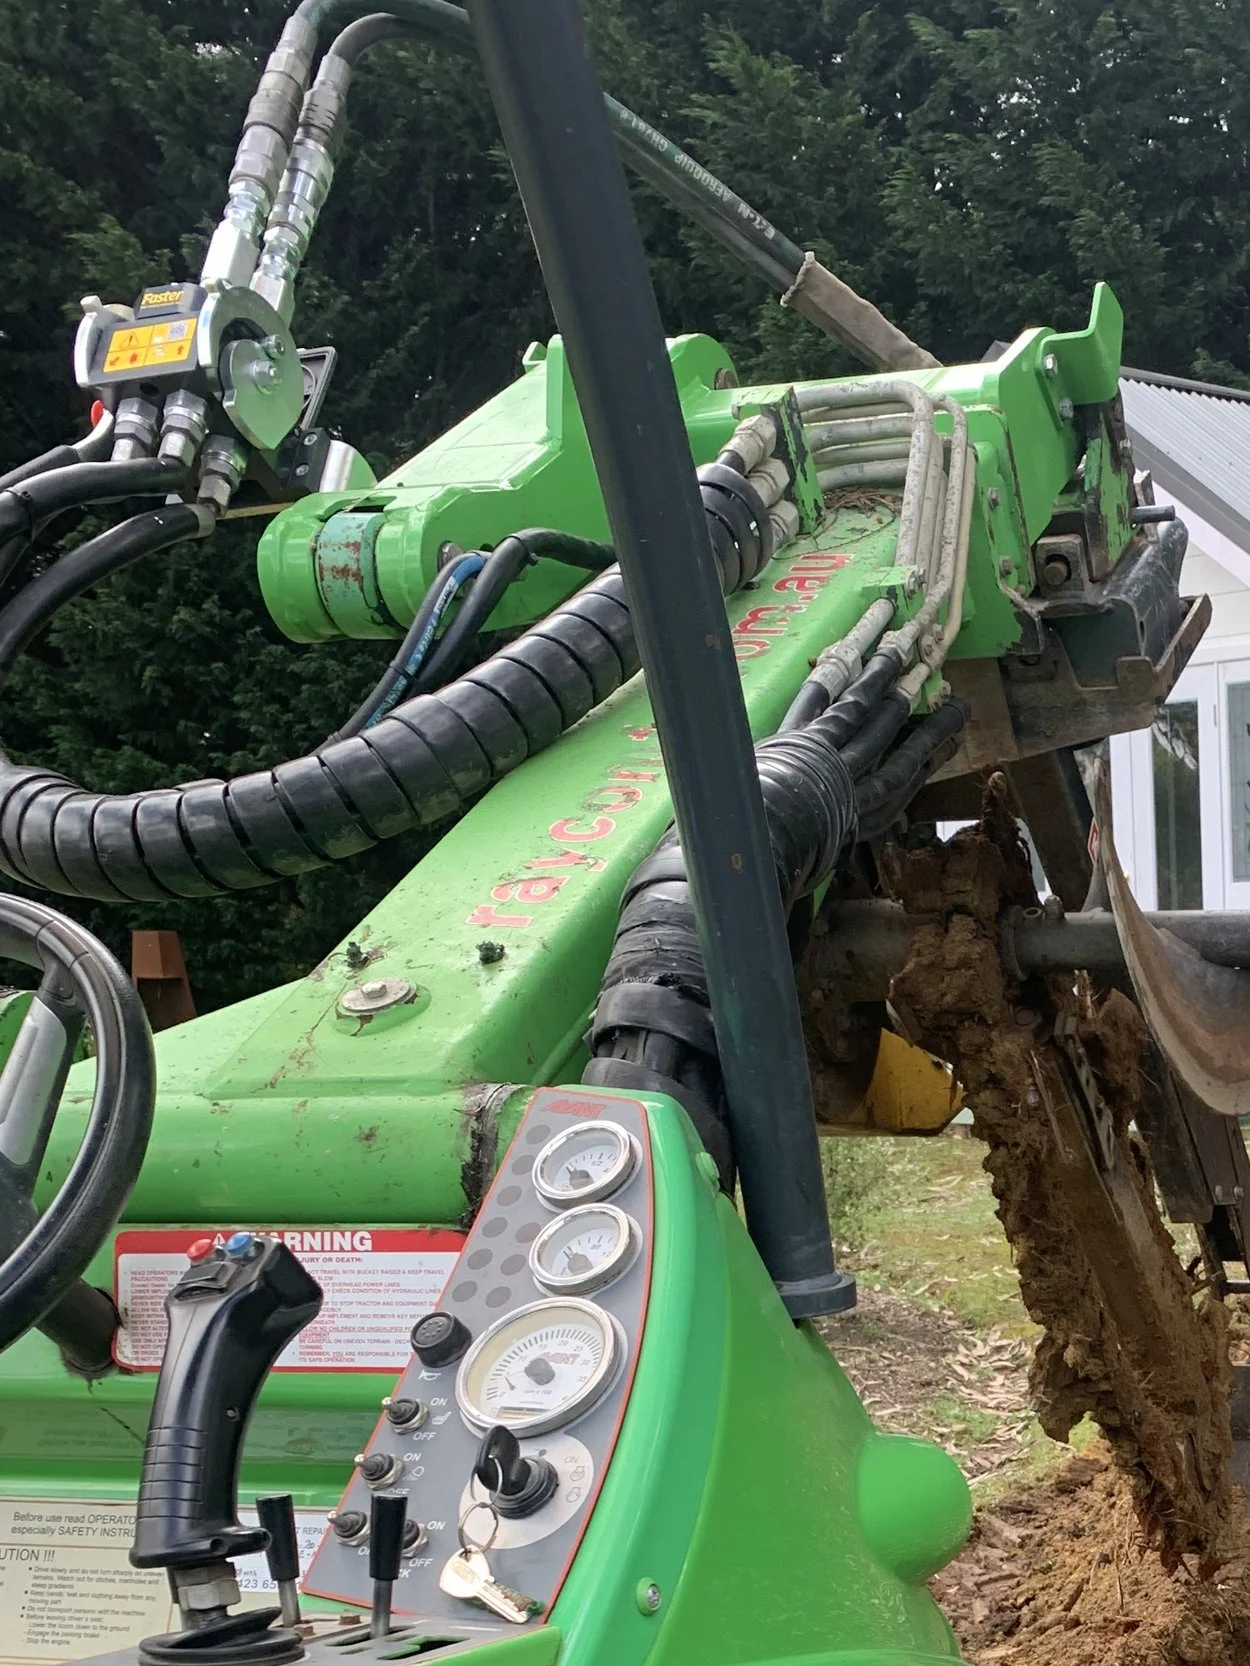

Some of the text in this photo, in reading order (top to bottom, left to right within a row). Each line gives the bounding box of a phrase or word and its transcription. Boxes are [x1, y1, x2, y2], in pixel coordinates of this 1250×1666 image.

[673, 153, 732, 203] AEROQUIP
[142, 290, 184, 306] Faster
[251, 1231, 373, 1252] RNING
[431, 1398, 448, 1406] ON
[412, 1432, 436, 1441] OFF
[403, 1453, 421, 1462] ON
[13, 1511, 138, 1525] Before use read OPERATO
[427, 1521, 446, 1530] ON
[11, 1526, 137, 1538] especially SAFETY INSTRU
[302, 1527, 324, 1535] REPA
[0, 1548, 39, 1561] UTION
[409, 1558, 433, 1568] OFF
[262, 1580, 277, 1590] 65
